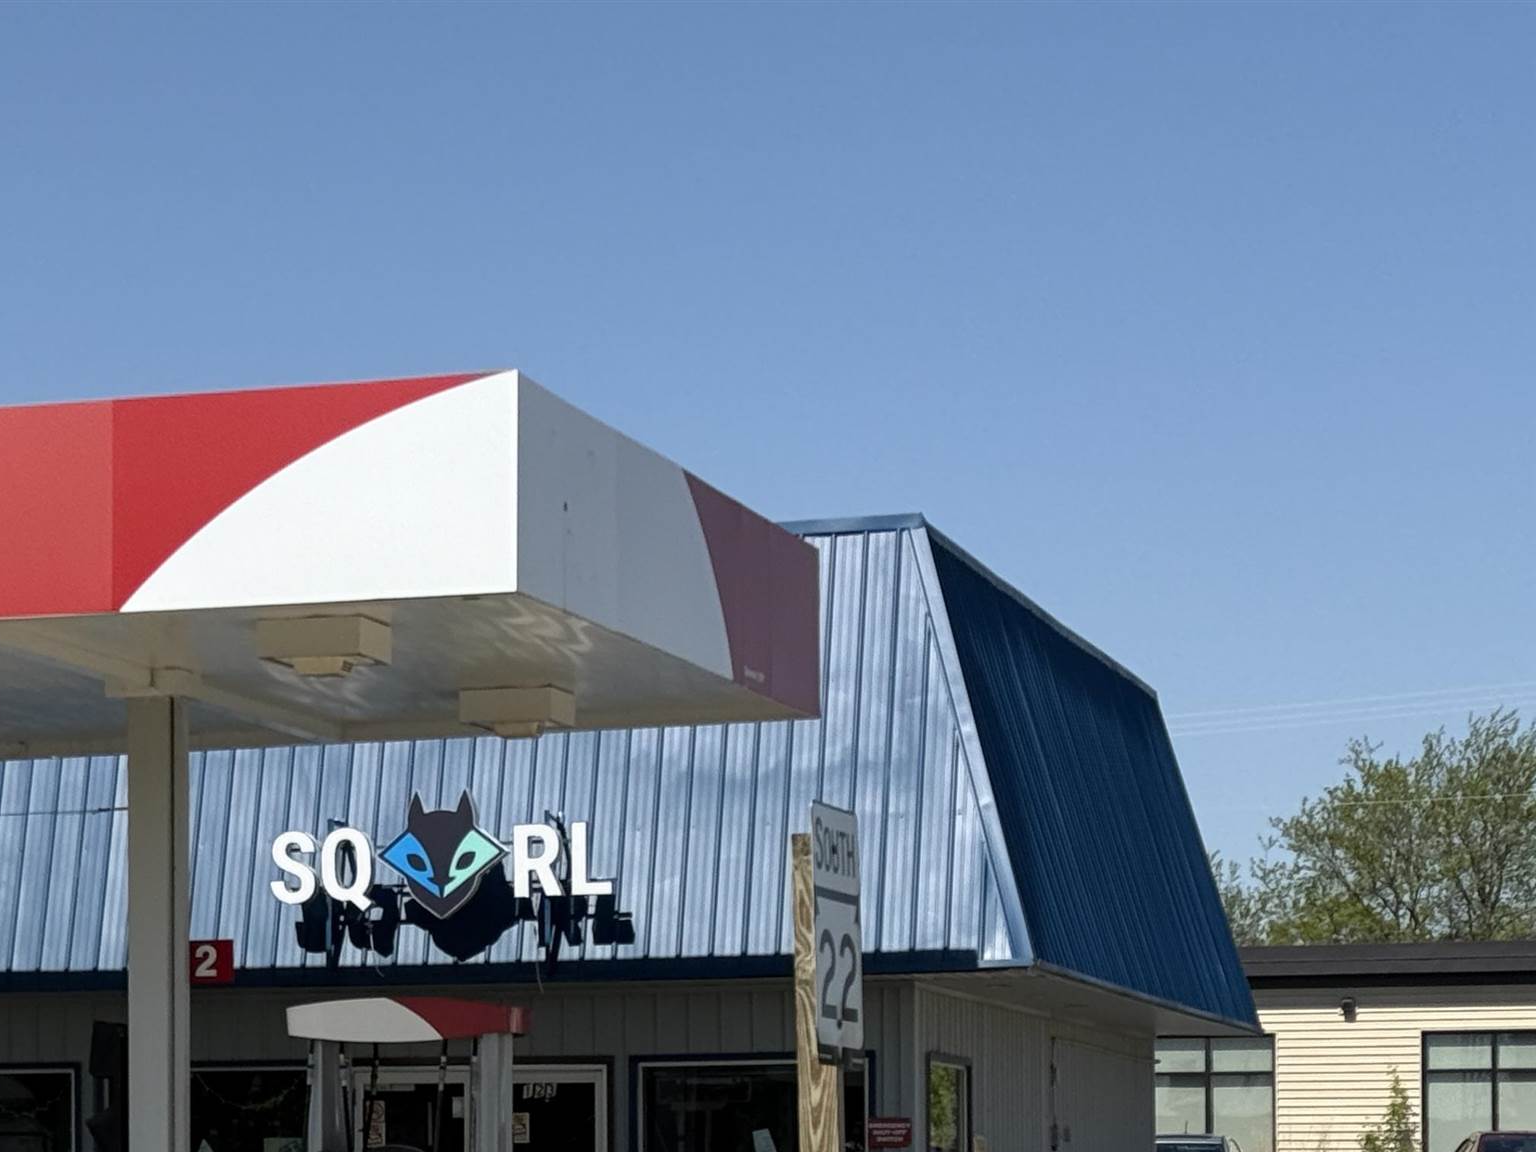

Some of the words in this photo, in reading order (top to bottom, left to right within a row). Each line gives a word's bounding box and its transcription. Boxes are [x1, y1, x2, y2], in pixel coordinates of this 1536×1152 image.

[815, 817, 855, 878] SOUTH
[194, 944, 218, 978] 2
[819, 929, 859, 1023] 22
